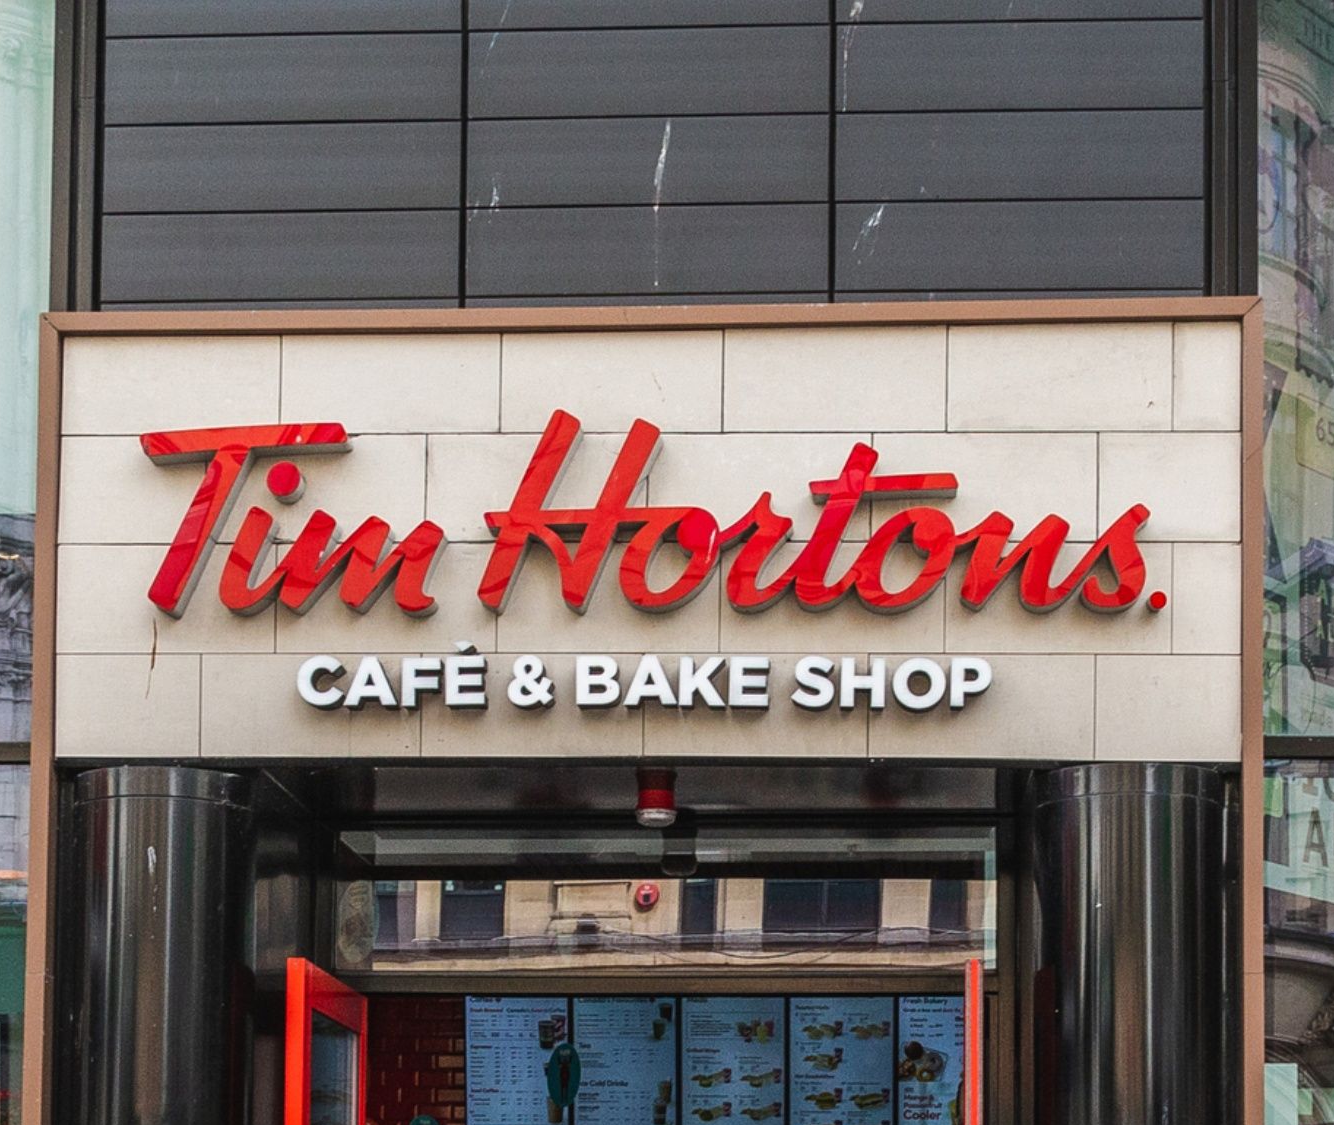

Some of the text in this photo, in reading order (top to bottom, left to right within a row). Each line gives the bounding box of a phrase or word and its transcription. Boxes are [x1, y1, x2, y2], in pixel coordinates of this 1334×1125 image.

[140, 422, 442, 616] Tim
[296, 642, 993, 712] CAFÉ & BAKE SHOP
[903, 1109, 942, 1121] Cooler
